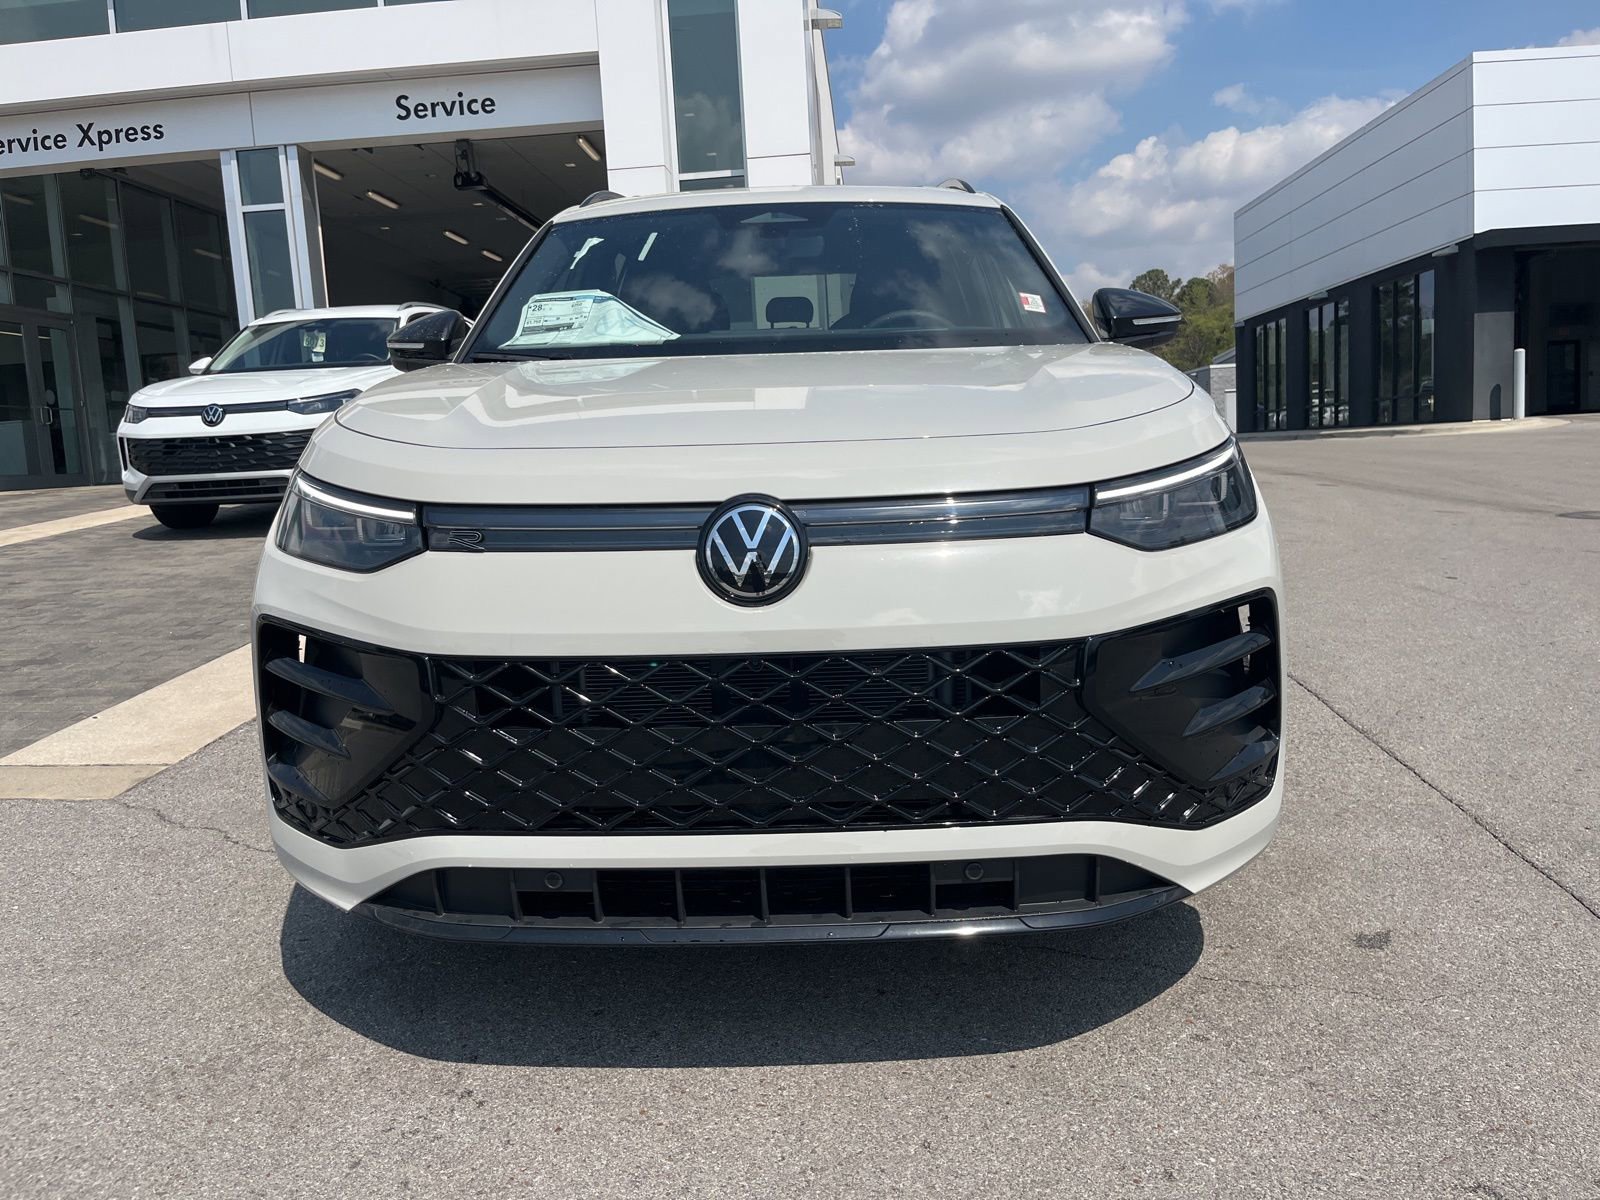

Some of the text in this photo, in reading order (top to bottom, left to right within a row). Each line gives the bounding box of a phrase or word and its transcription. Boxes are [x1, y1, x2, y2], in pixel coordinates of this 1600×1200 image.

[395, 91, 496, 121] Service
[76, 122, 164, 151] Xpress
[202, 404, 223, 426] VW
[705, 505, 800, 598] VW
